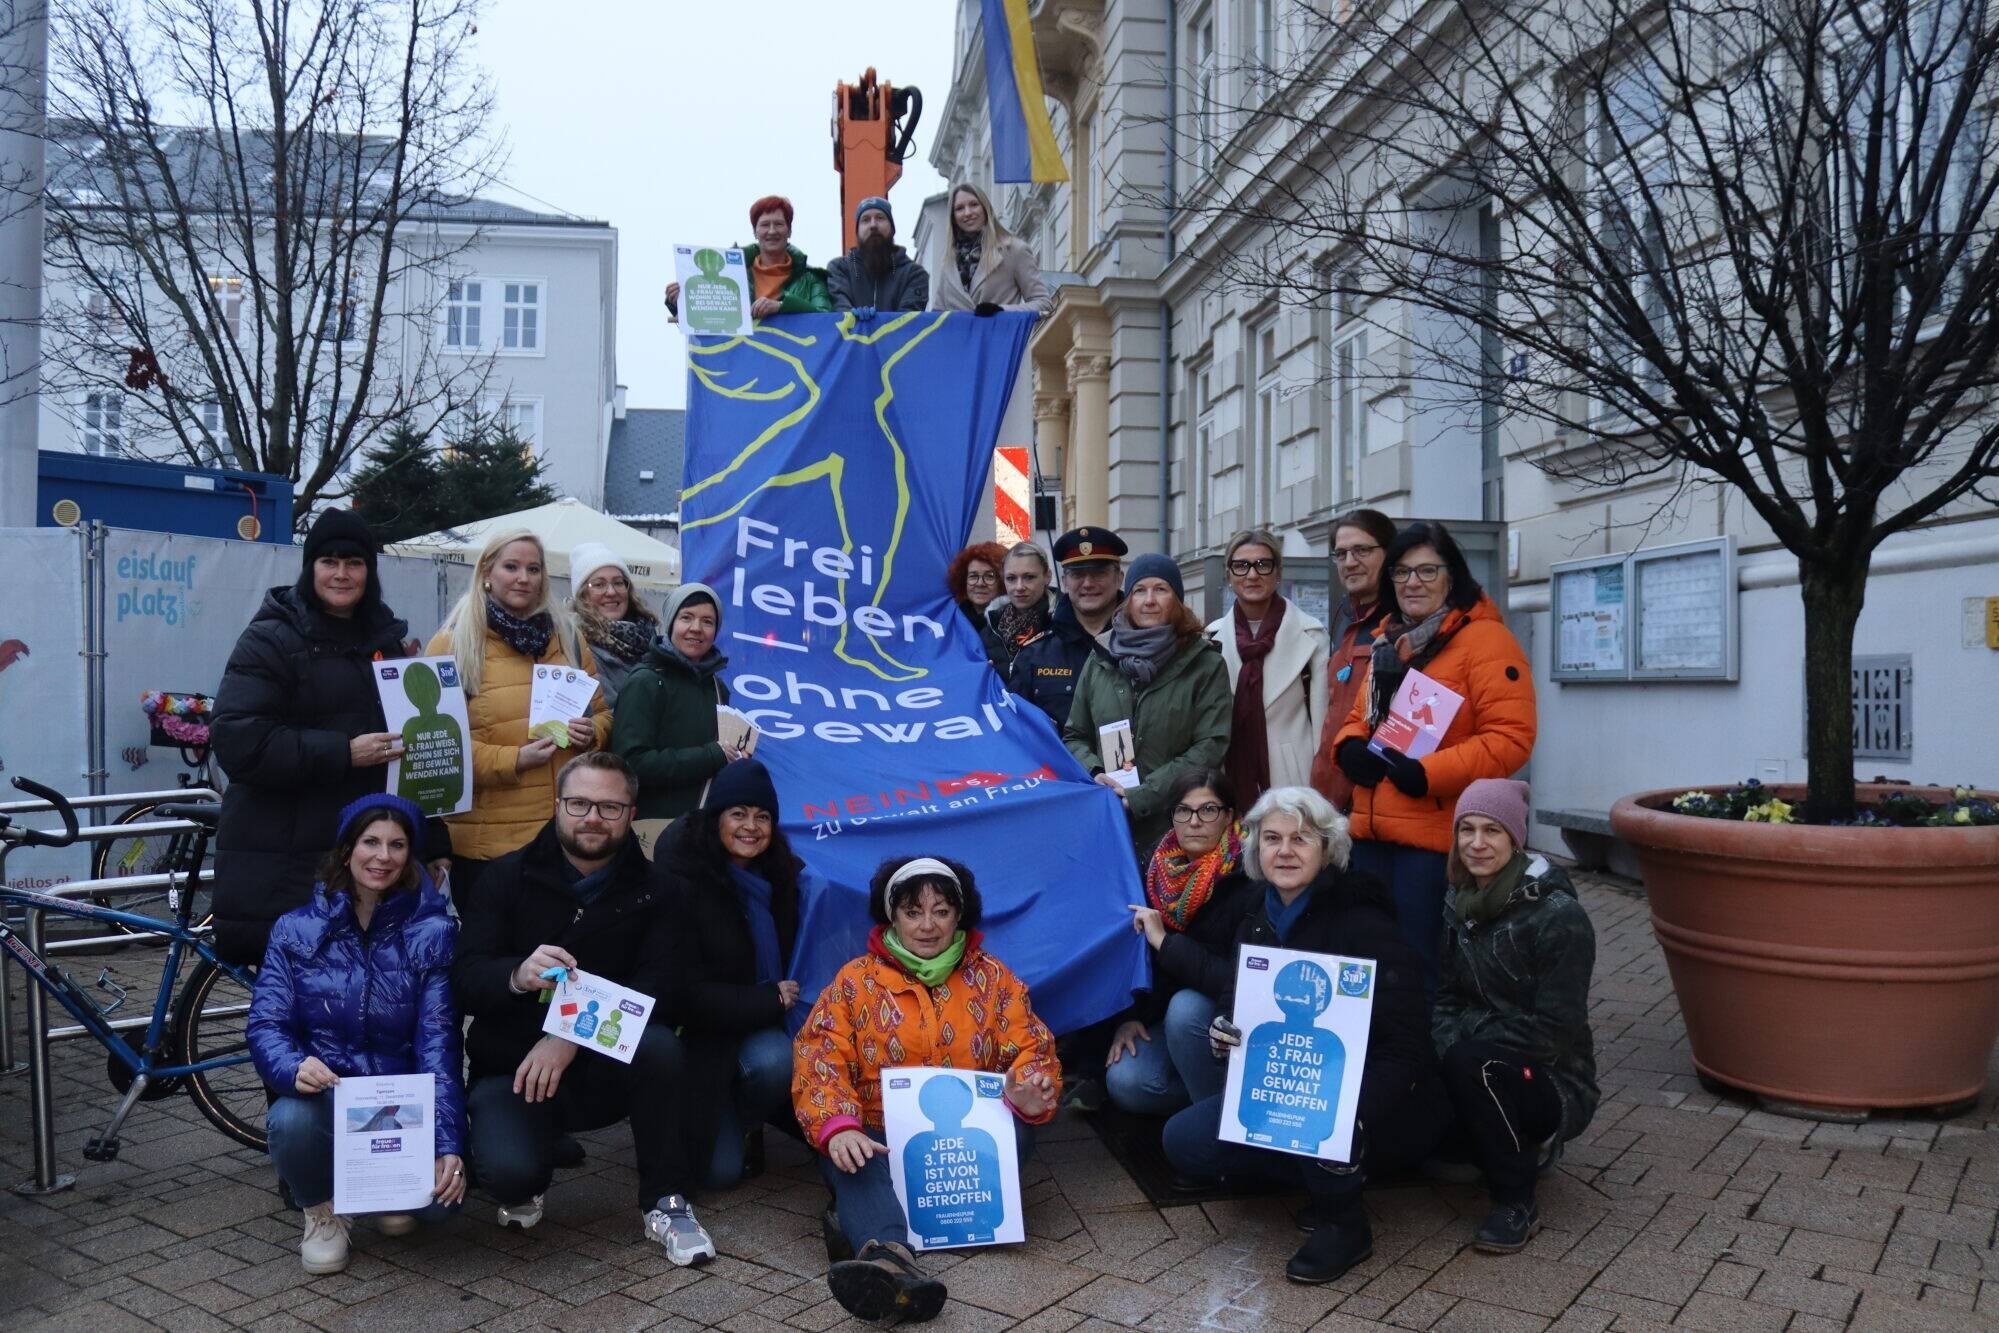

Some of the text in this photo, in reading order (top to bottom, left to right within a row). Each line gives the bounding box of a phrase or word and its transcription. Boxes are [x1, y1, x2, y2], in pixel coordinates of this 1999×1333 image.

[736, 516, 873, 586] Frei
[117, 549, 196, 590] eislauf
[117, 586, 178, 626] platz
[732, 567, 945, 643] leben
[1037, 668, 1072, 676] POLIZEI
[732, 671, 944, 711] ohne
[416, 730, 448, 741] NUR JEDE
[406, 747, 460, 761] WOHIN SIE SICH
[408, 744, 416, 752] 5.
[416, 742, 434, 751] FRAU
[412, 757, 454, 770] BEI GEWALT
[406, 766, 460, 780] WENDEN KANN
[802, 780, 932, 821] NEIN
[949, 795, 978, 810] an
[1278, 1032, 1314, 1050] JEDE
[1268, 1046, 1323, 1066] 3. FRAU
[1266, 1061, 1322, 1081] IST VON
[1263, 1075, 1320, 1094] GEWALT
[1251, 1088, 1328, 1112] BETROFFEN
[931, 1137, 965, 1152] JEDE
[924, 1150, 976, 1166] 3. FRAU
[925, 1165, 978, 1180] IST VON
[926, 1178, 980, 1194] GEWALT
[918, 1191, 992, 1208] BETROFFEN
